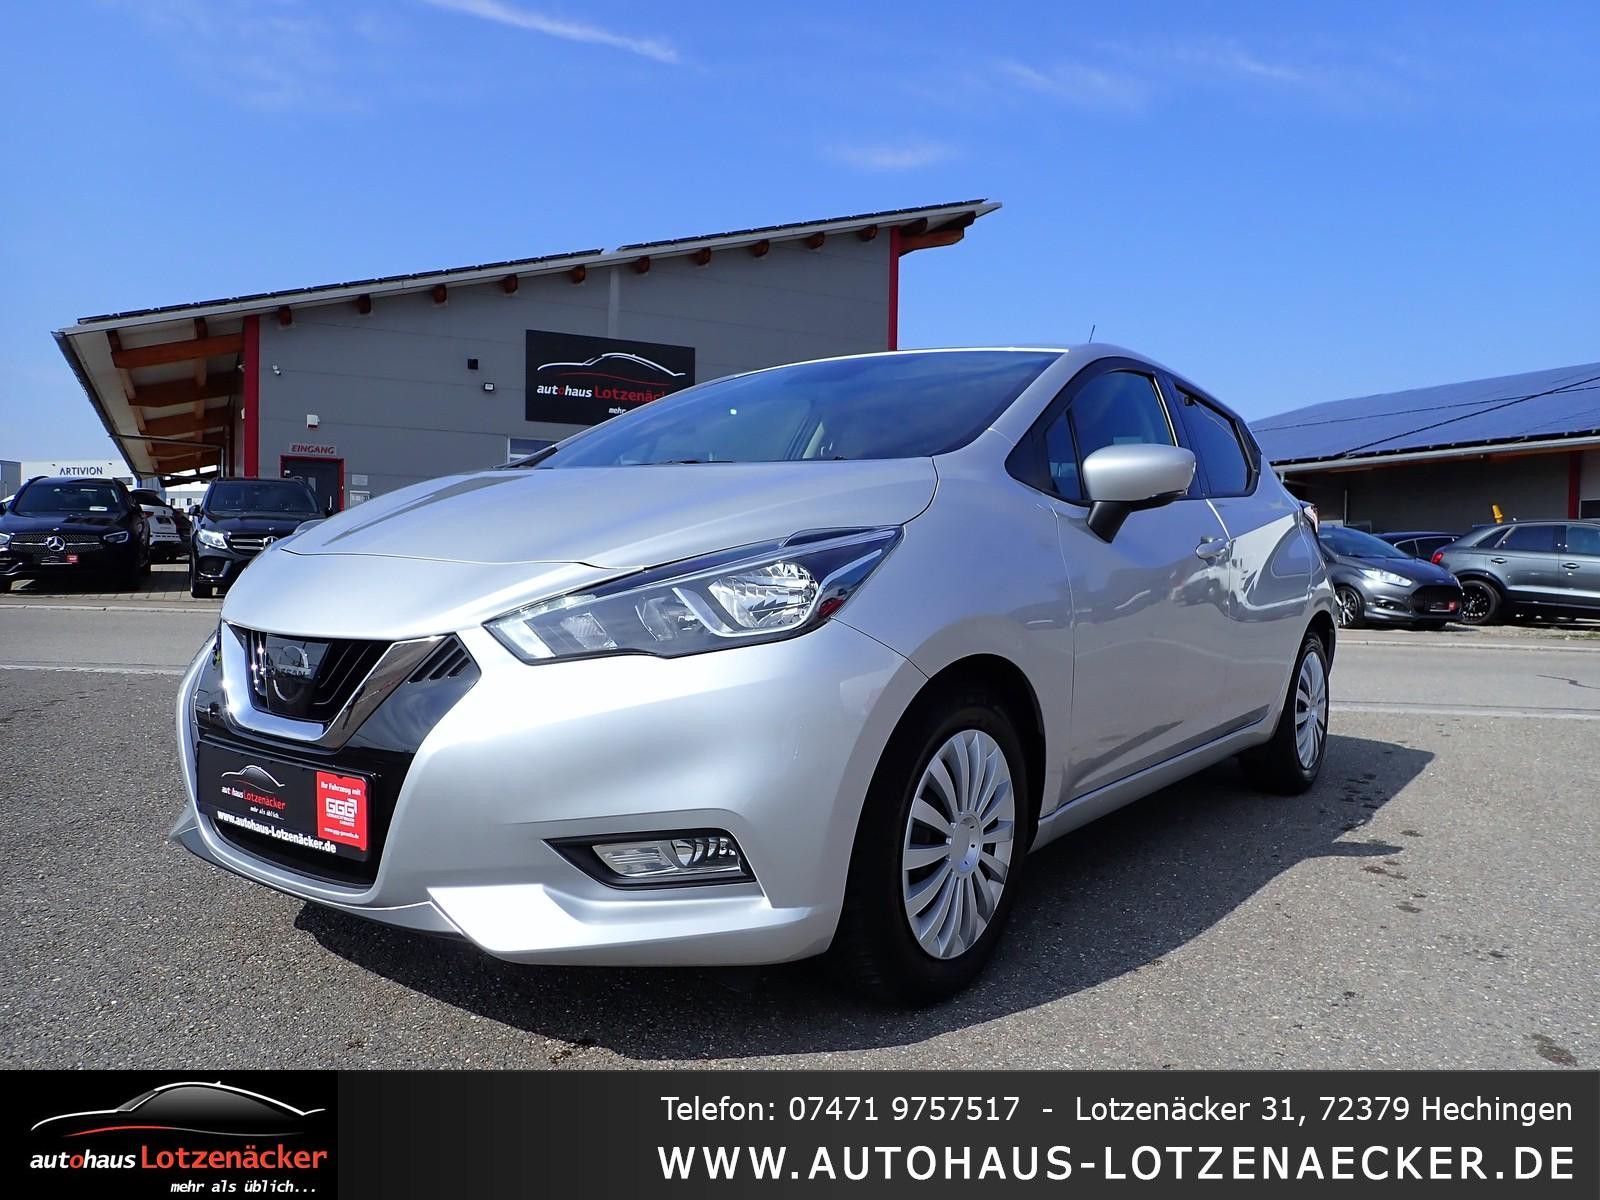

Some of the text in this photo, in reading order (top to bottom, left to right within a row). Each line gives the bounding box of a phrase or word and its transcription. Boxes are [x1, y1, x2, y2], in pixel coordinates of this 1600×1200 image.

[537, 384, 665, 402] autohaus Lotzenäc
[292, 444, 335, 454] EINGANG
[59, 466, 103, 476] ARTIVION
[320, 781, 361, 796] Ihr Fahrzeug mit
[244, 790, 286, 810] Lotzenäcker
[325, 797, 357, 817] GGG
[217, 810, 337, 854] www.autohaus-Lotzenäcker.de
